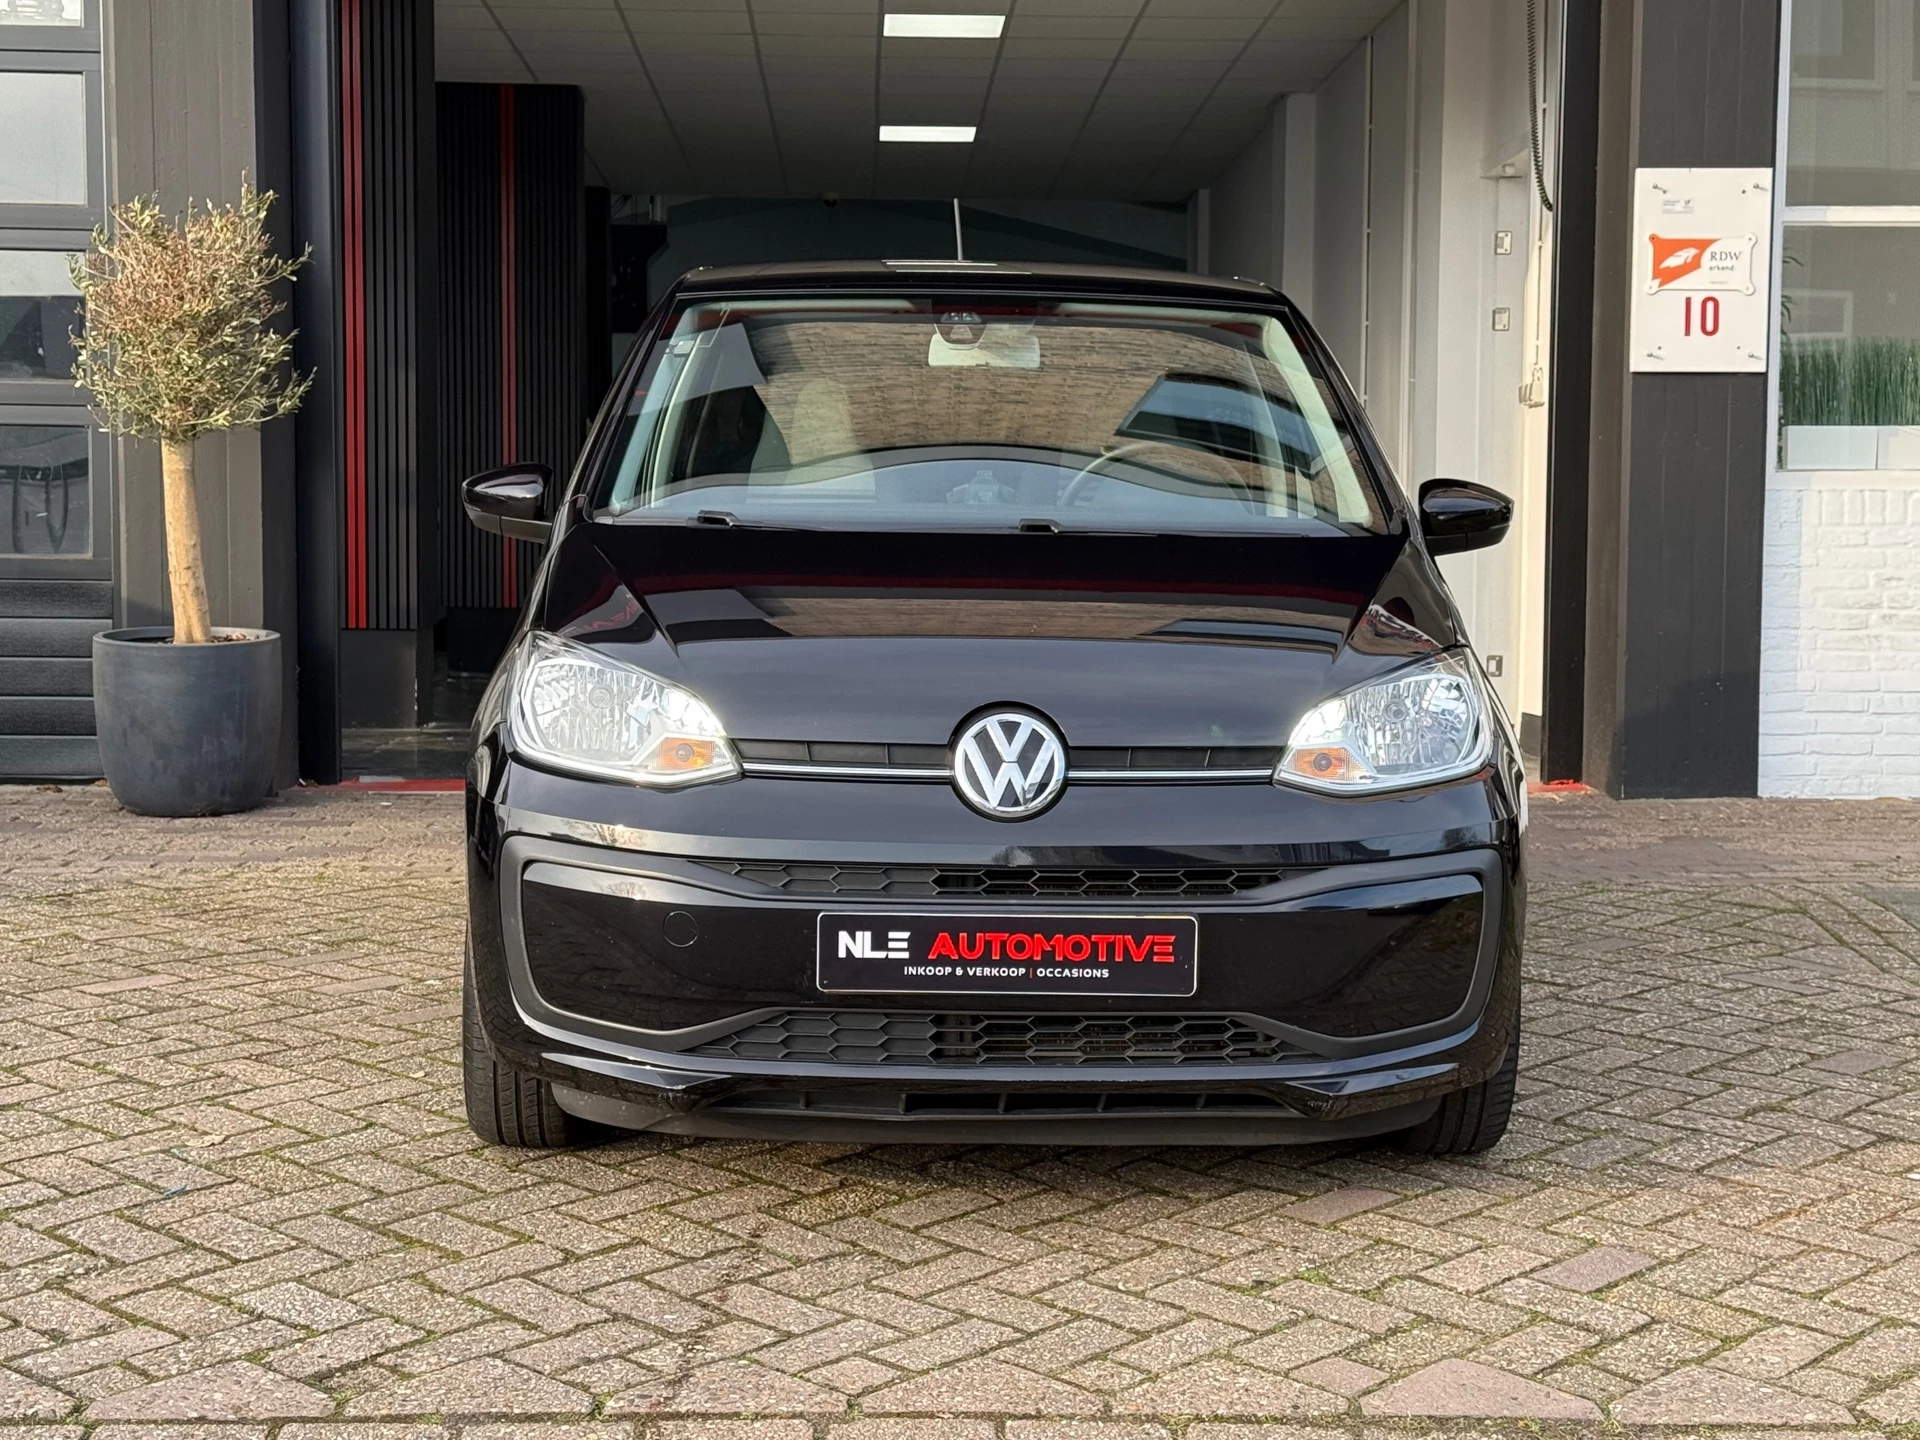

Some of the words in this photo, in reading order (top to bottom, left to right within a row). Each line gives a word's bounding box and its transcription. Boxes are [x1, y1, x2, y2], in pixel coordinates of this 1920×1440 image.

[1710, 251, 1742, 261] RDW
[1684, 296, 1720, 337] 10
[837, 930, 911, 959] NLE
[927, 932, 1176, 962] AUTOMOTIVE
[904, 966, 952, 976] INKOOP
[955, 966, 964, 976] &
[967, 967, 1026, 977] VERKOOP
[1036, 968, 1110, 979] OCCASIONS
